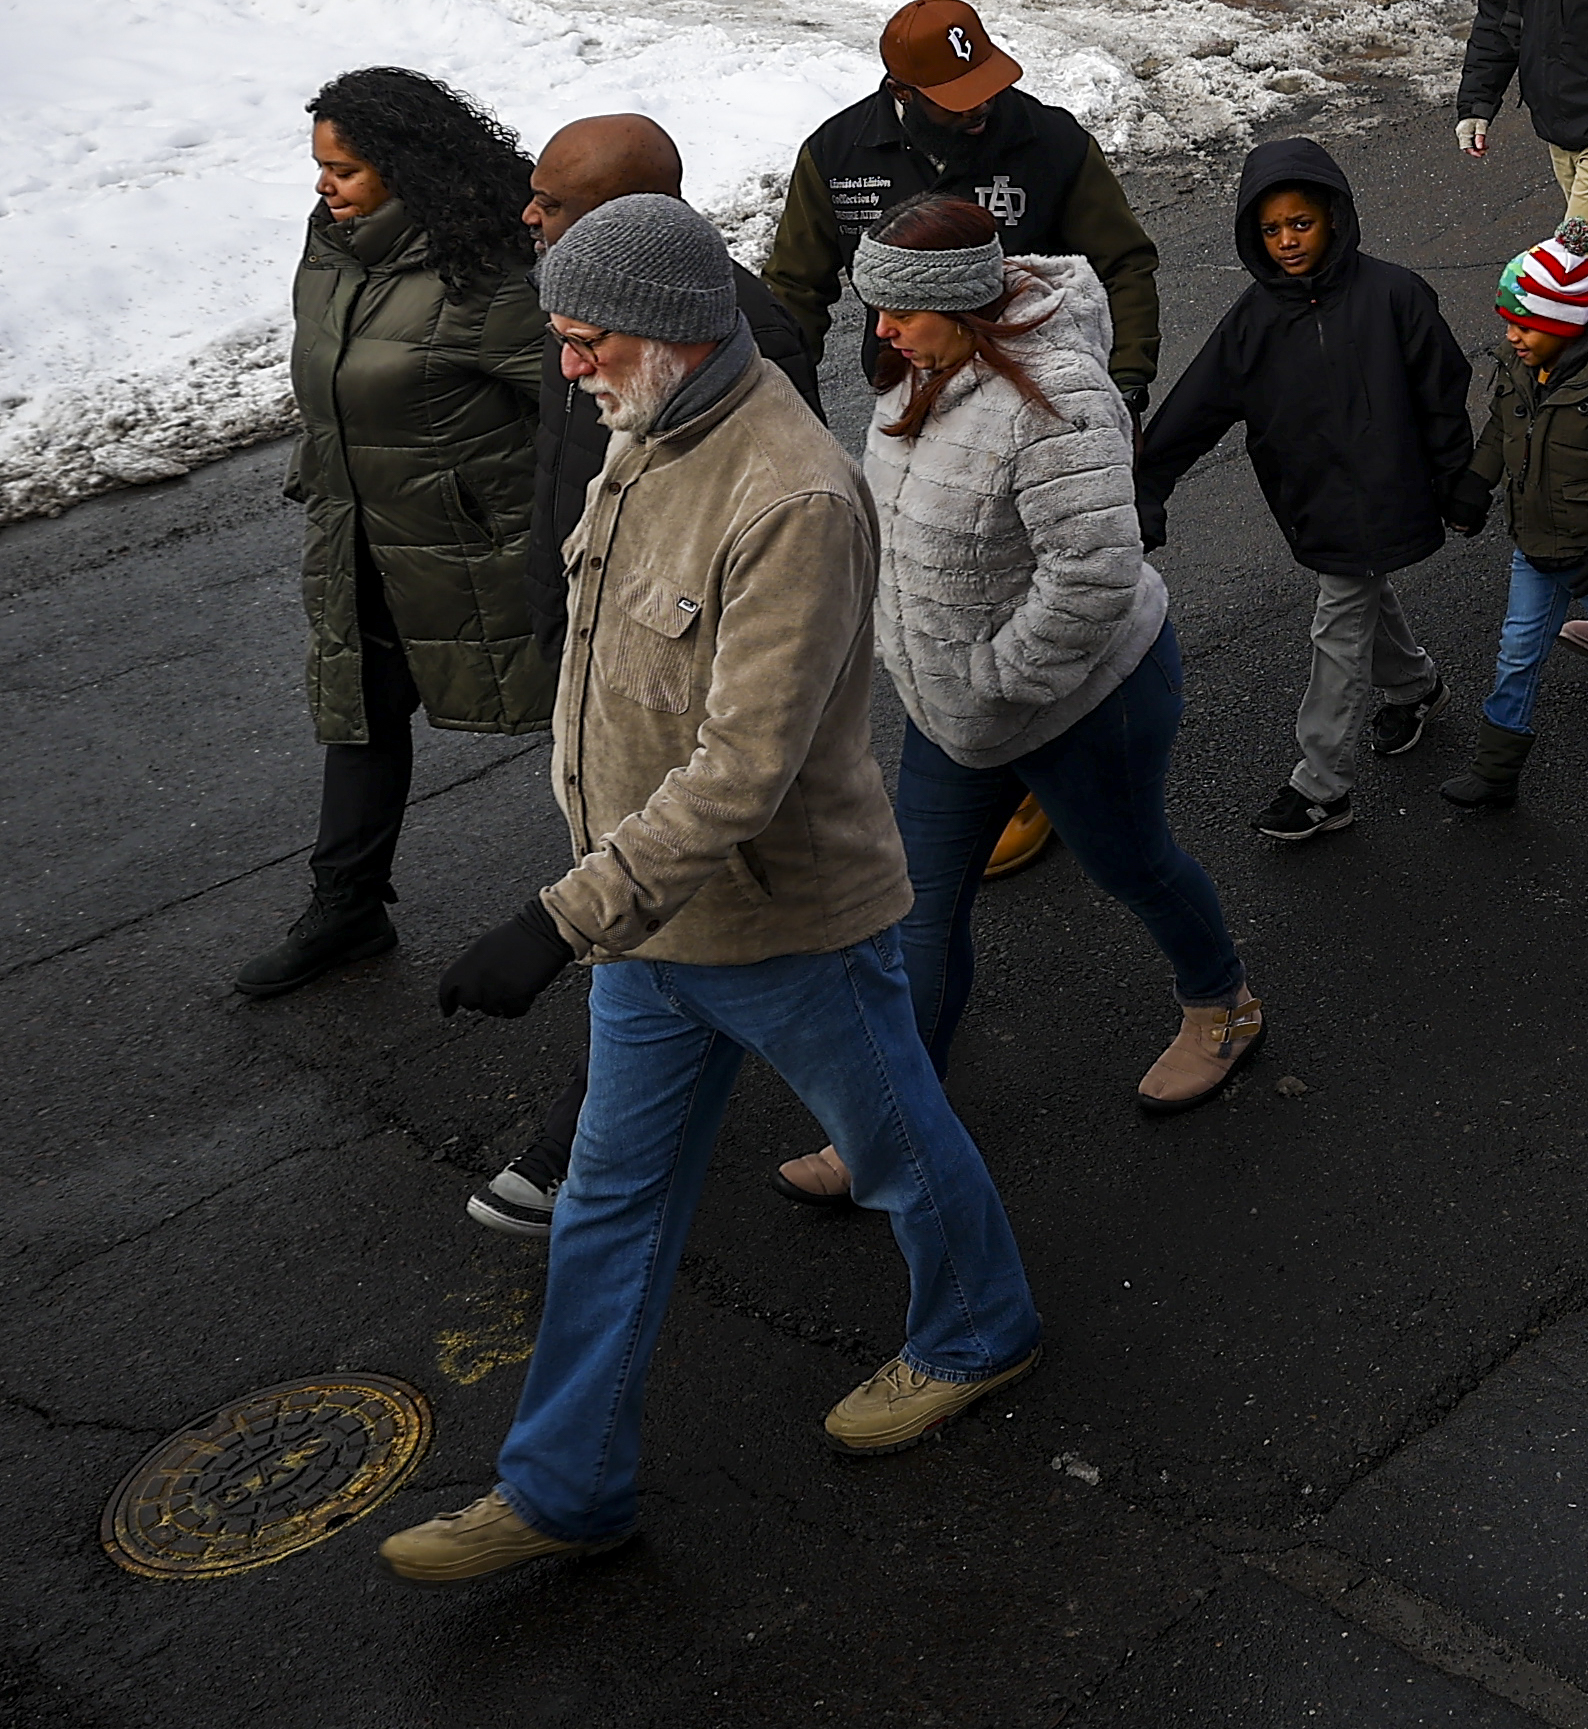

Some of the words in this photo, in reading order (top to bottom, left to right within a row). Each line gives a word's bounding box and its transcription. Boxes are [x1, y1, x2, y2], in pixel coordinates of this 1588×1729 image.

[829, 177, 862, 189] Limited
[863, 176, 891, 188] Edition
[831, 193, 869, 205] Collection
[870, 192, 880, 207] by
[208, 1434, 332, 1511] GAS
